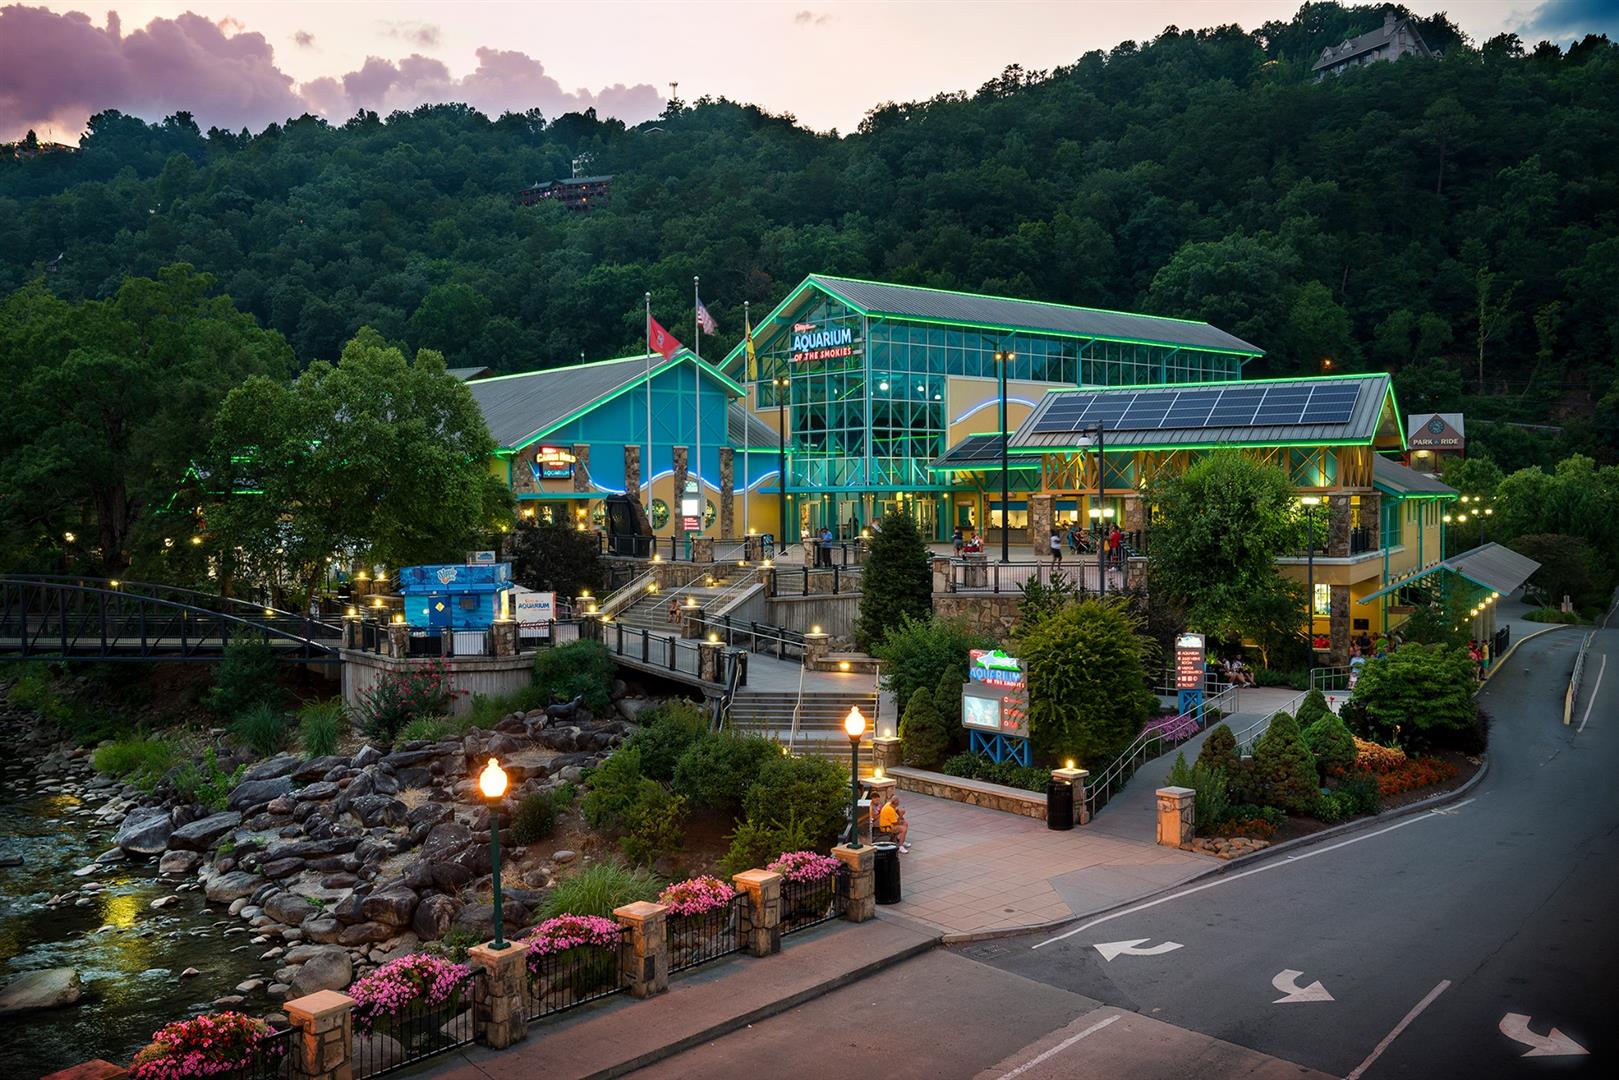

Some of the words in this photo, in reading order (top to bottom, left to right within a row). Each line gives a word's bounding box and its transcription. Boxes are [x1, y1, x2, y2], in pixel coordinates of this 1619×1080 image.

[794, 328, 852, 352] AQUARIUM
[794, 354, 803, 362] OF
[804, 351, 819, 360] THE
[820, 347, 852, 359] SMOKIES
[970, 667, 1020, 681] AQUARIUM
